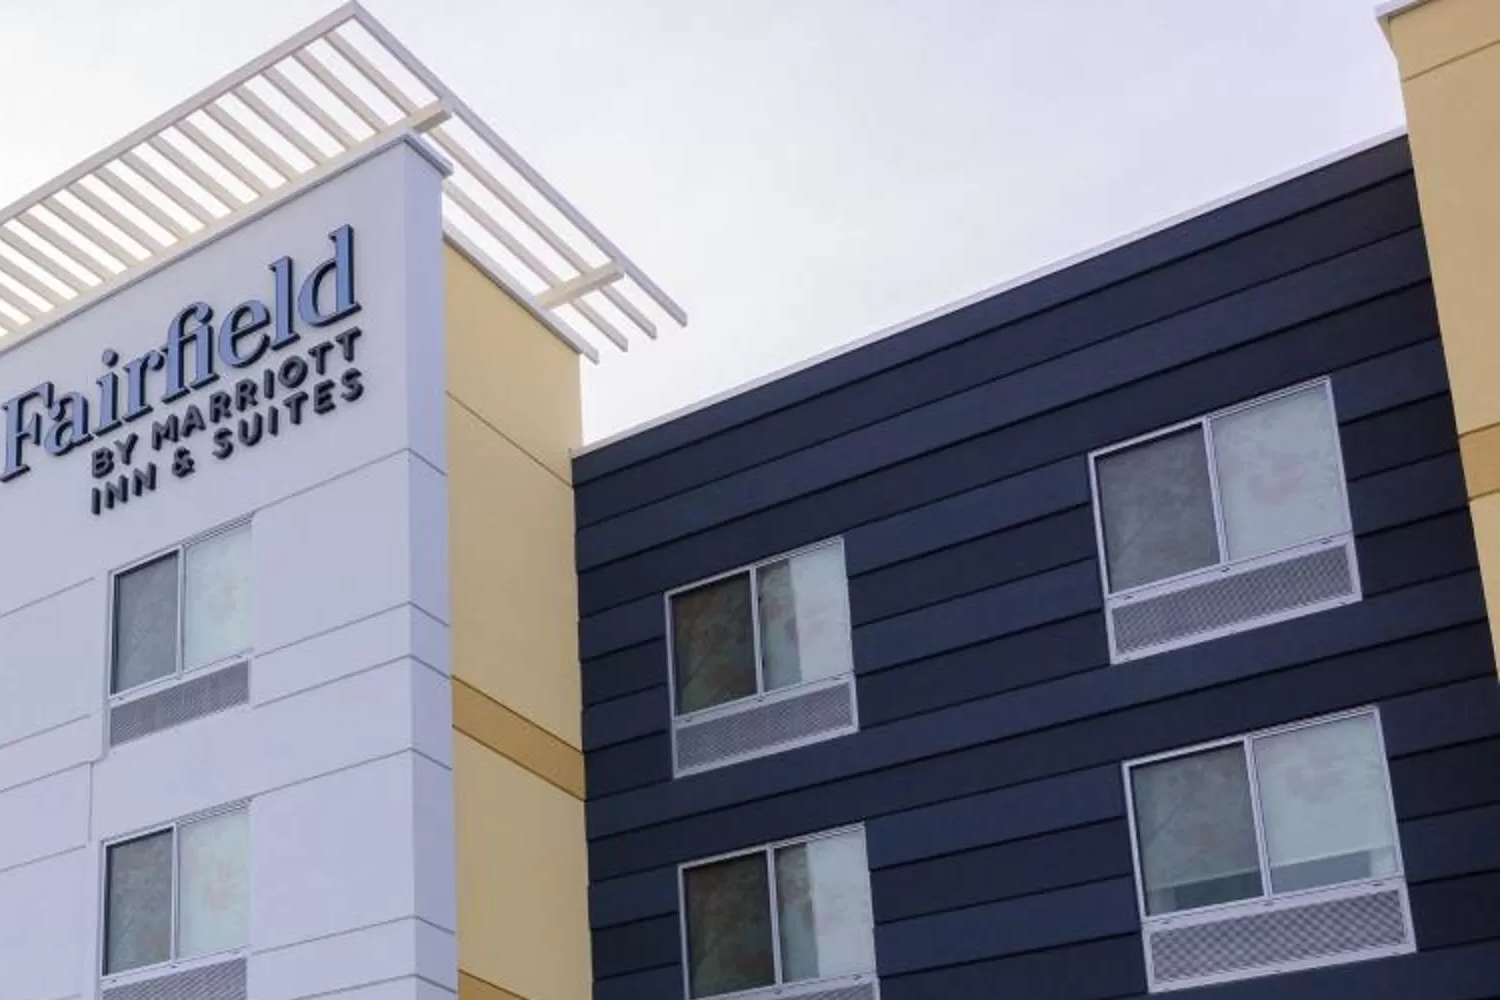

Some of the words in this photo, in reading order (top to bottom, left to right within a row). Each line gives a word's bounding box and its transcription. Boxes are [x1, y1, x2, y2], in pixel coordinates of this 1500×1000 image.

[0, 224, 362, 483] Fairfield
[92, 433, 139, 479] BY
[151, 326, 363, 451] MARRIOTT
[91, 462, 158, 516] INN
[172, 447, 195, 478] &
[213, 367, 365, 460] SUITES
